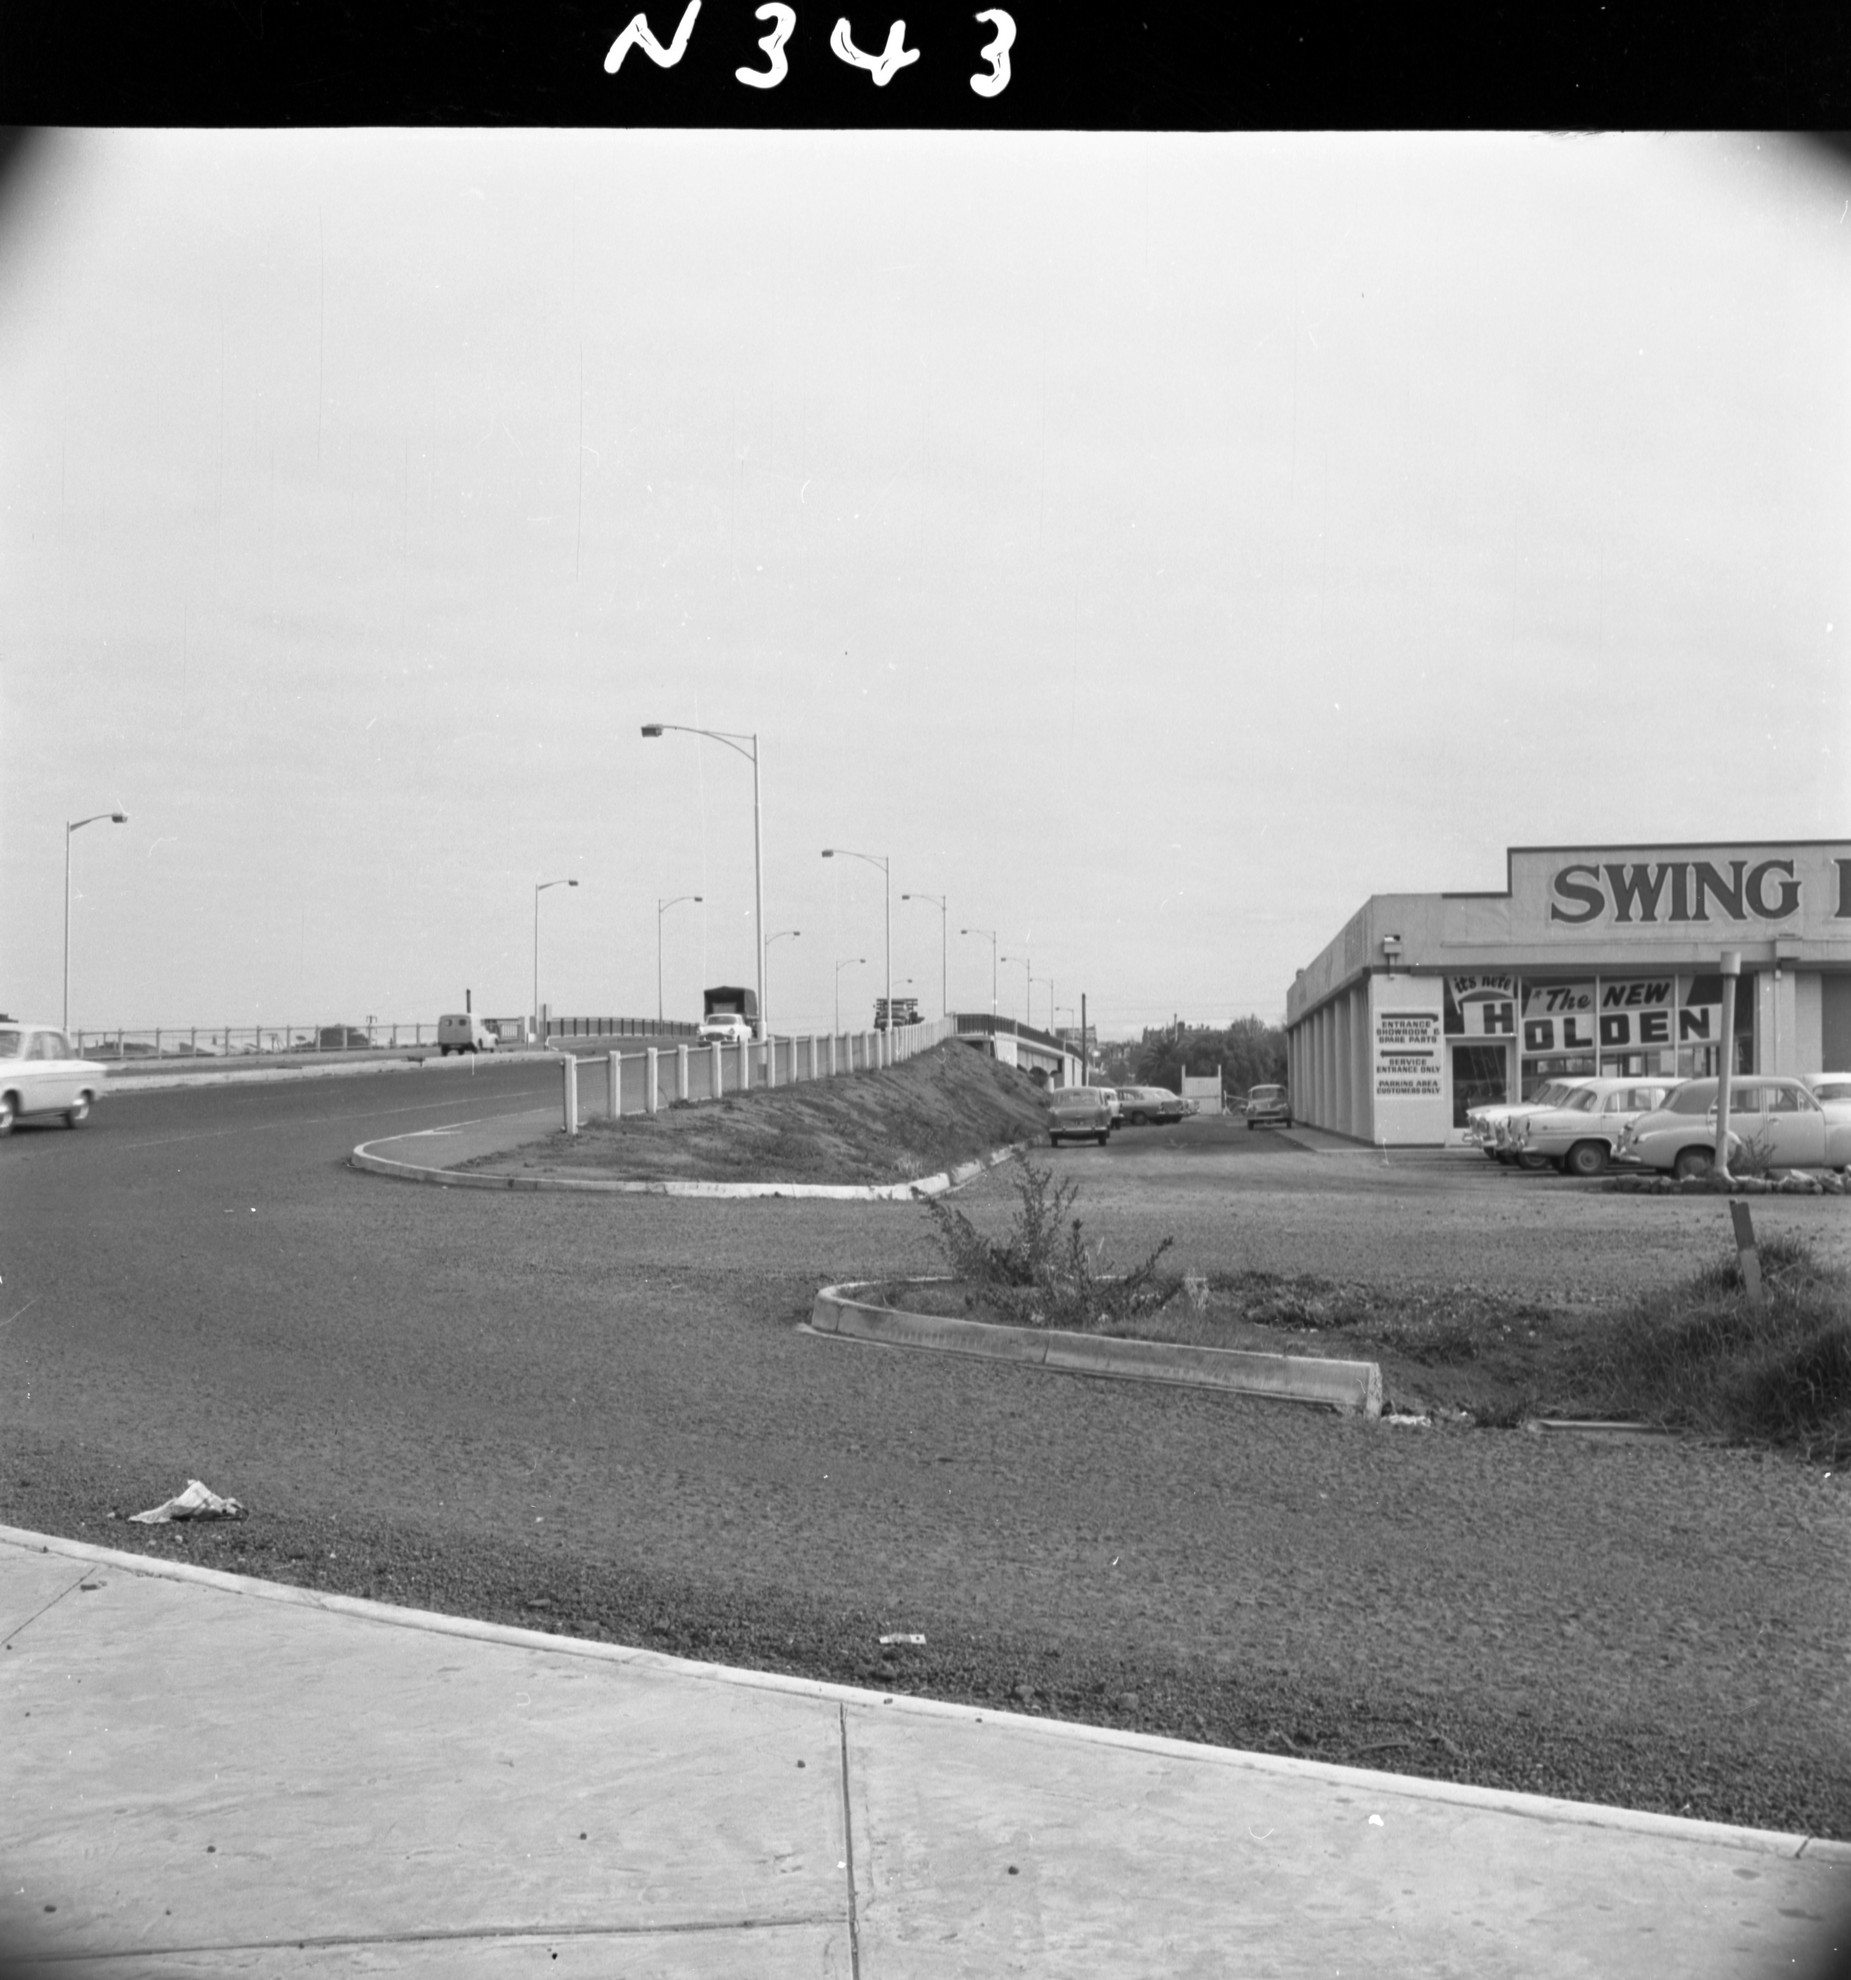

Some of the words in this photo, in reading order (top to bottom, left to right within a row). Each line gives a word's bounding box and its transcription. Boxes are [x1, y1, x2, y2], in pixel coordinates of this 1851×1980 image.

[1551, 859, 1802, 924] SWING
[1546, 987, 1591, 1012] The
[1602, 982, 1671, 1008] NEW
[1376, 1028, 1428, 1036] SHOWROOM
[1378, 1036, 1406, 1044] SPARE
[1408, 1036, 1437, 1044] PARTS
[1388, 1058, 1427, 1066] SERVICE
[1376, 1066, 1418, 1074] ENTRANCE
[1420, 1066, 1441, 1074] ONLY
[1378, 1080, 1414, 1088] PARKING
[1416, 1080, 1439, 1088] AREA
[1376, 1087, 1421, 1095] CUSTOMERS
[1421, 1087, 1441, 1095] ONLY
